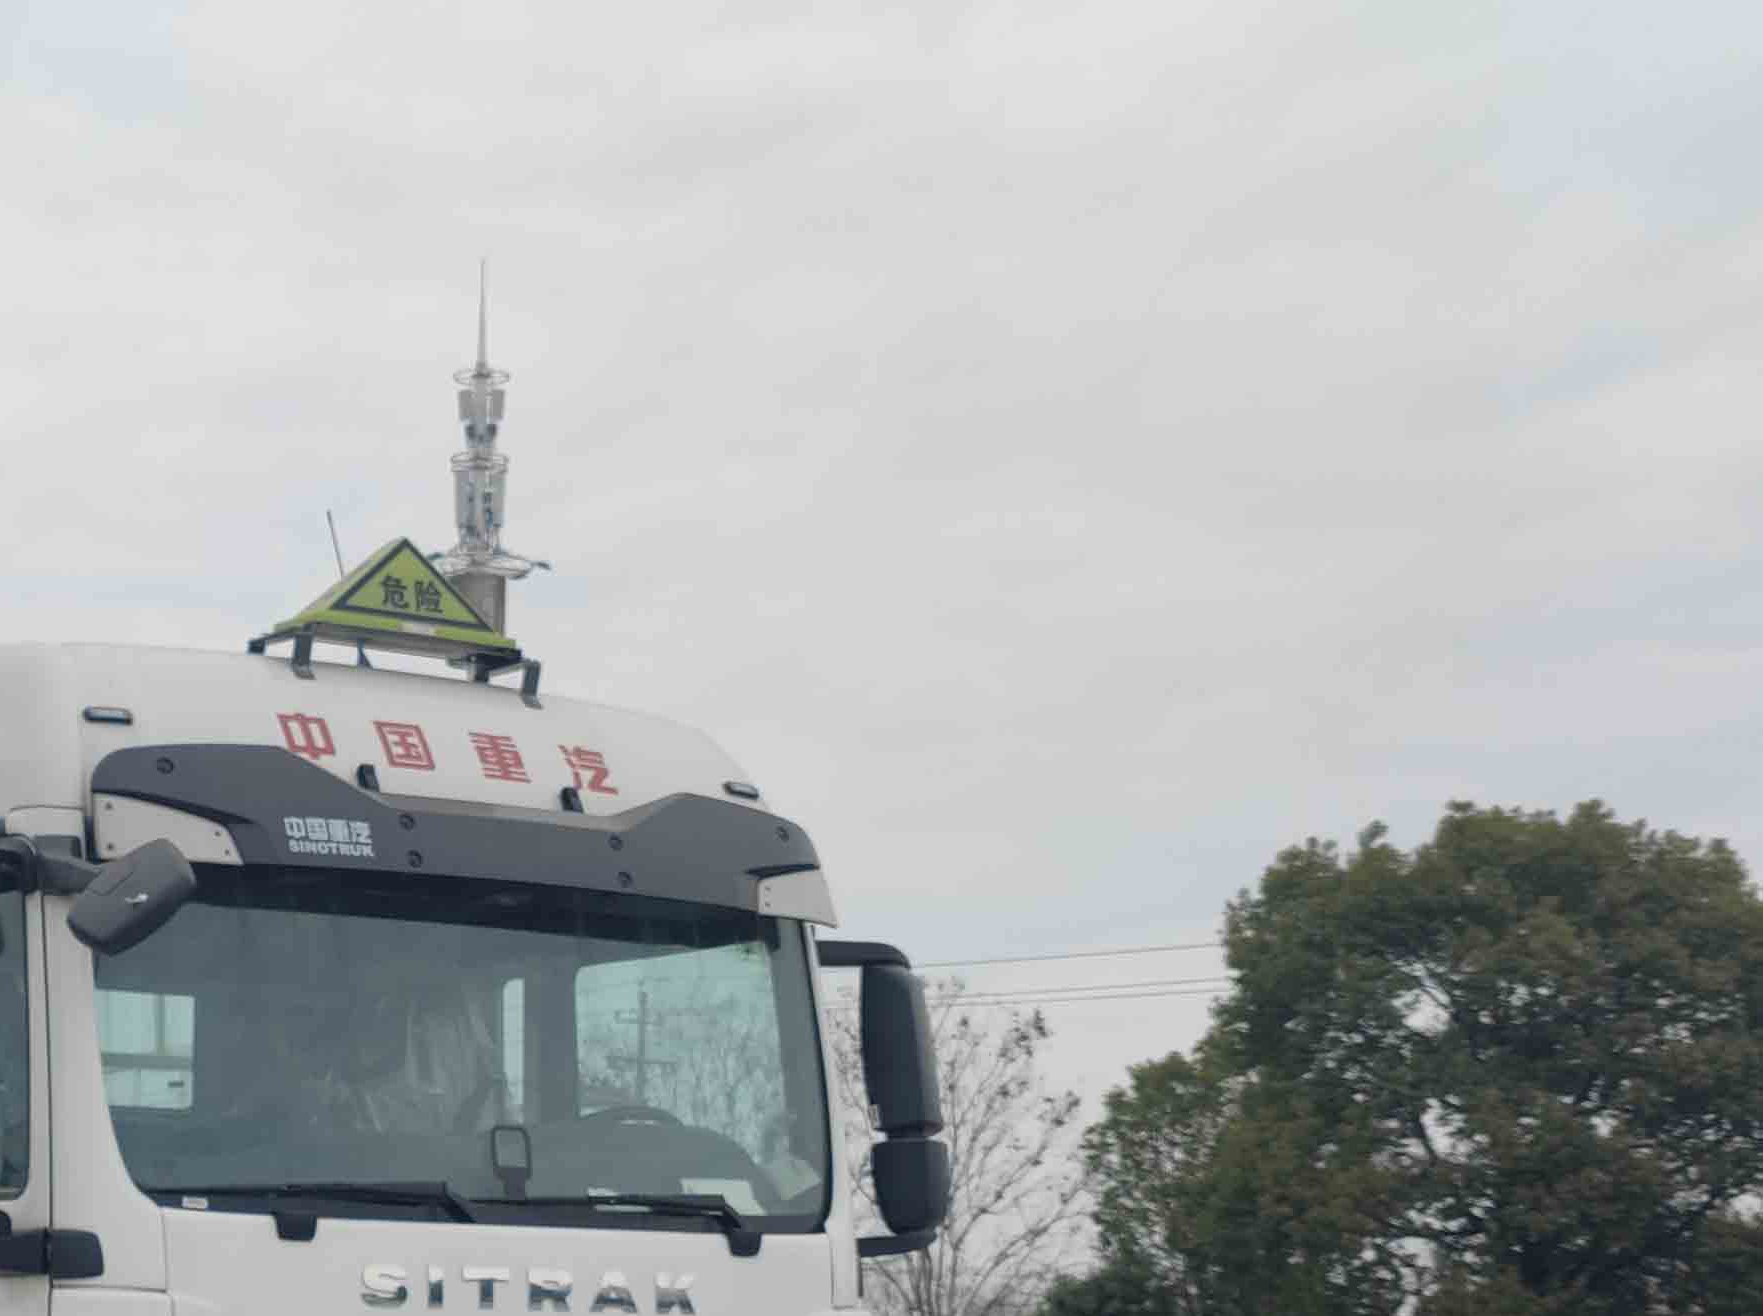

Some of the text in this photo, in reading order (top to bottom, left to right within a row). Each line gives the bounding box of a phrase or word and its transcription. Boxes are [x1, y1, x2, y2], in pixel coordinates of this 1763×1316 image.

[380, 573, 444, 614] 危险
[276, 712, 620, 796] 中国重汽
[282, 816, 372, 844] 中国重汽
[288, 839, 375, 857] SINOTRUK
[360, 1263, 698, 1316] SITRAK
